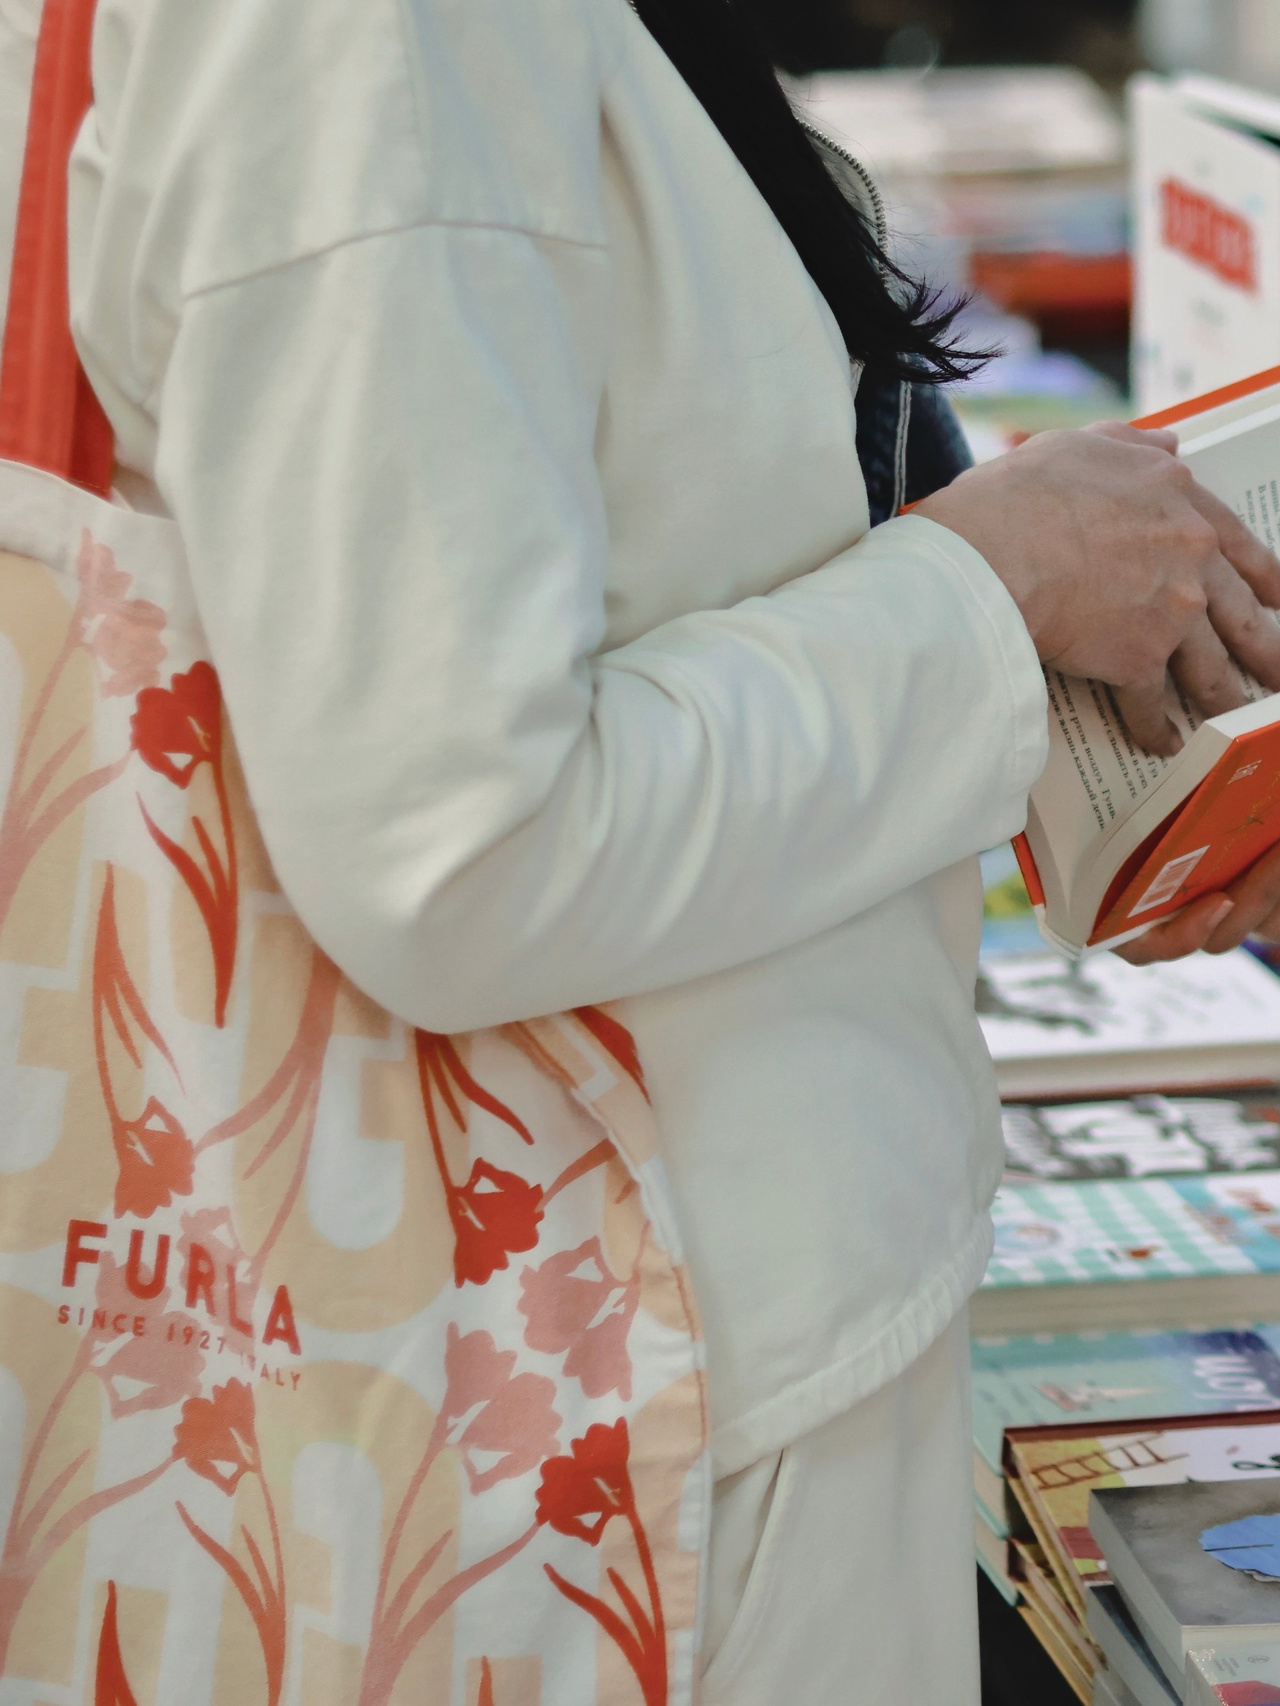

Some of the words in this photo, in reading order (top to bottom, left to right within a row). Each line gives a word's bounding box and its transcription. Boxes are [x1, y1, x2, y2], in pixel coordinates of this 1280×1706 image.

[1070, 716, 1087, 744] ртом
[1107, 729, 1129, 778] слышать
[1059, 718, 1077, 754] жизнь
[1074, 755, 1098, 801] каждый
[61, 1219, 302, 1356] FURLA
[57, 1304, 147, 1337] SINCE
[166, 1323, 227, 1354] 1927
